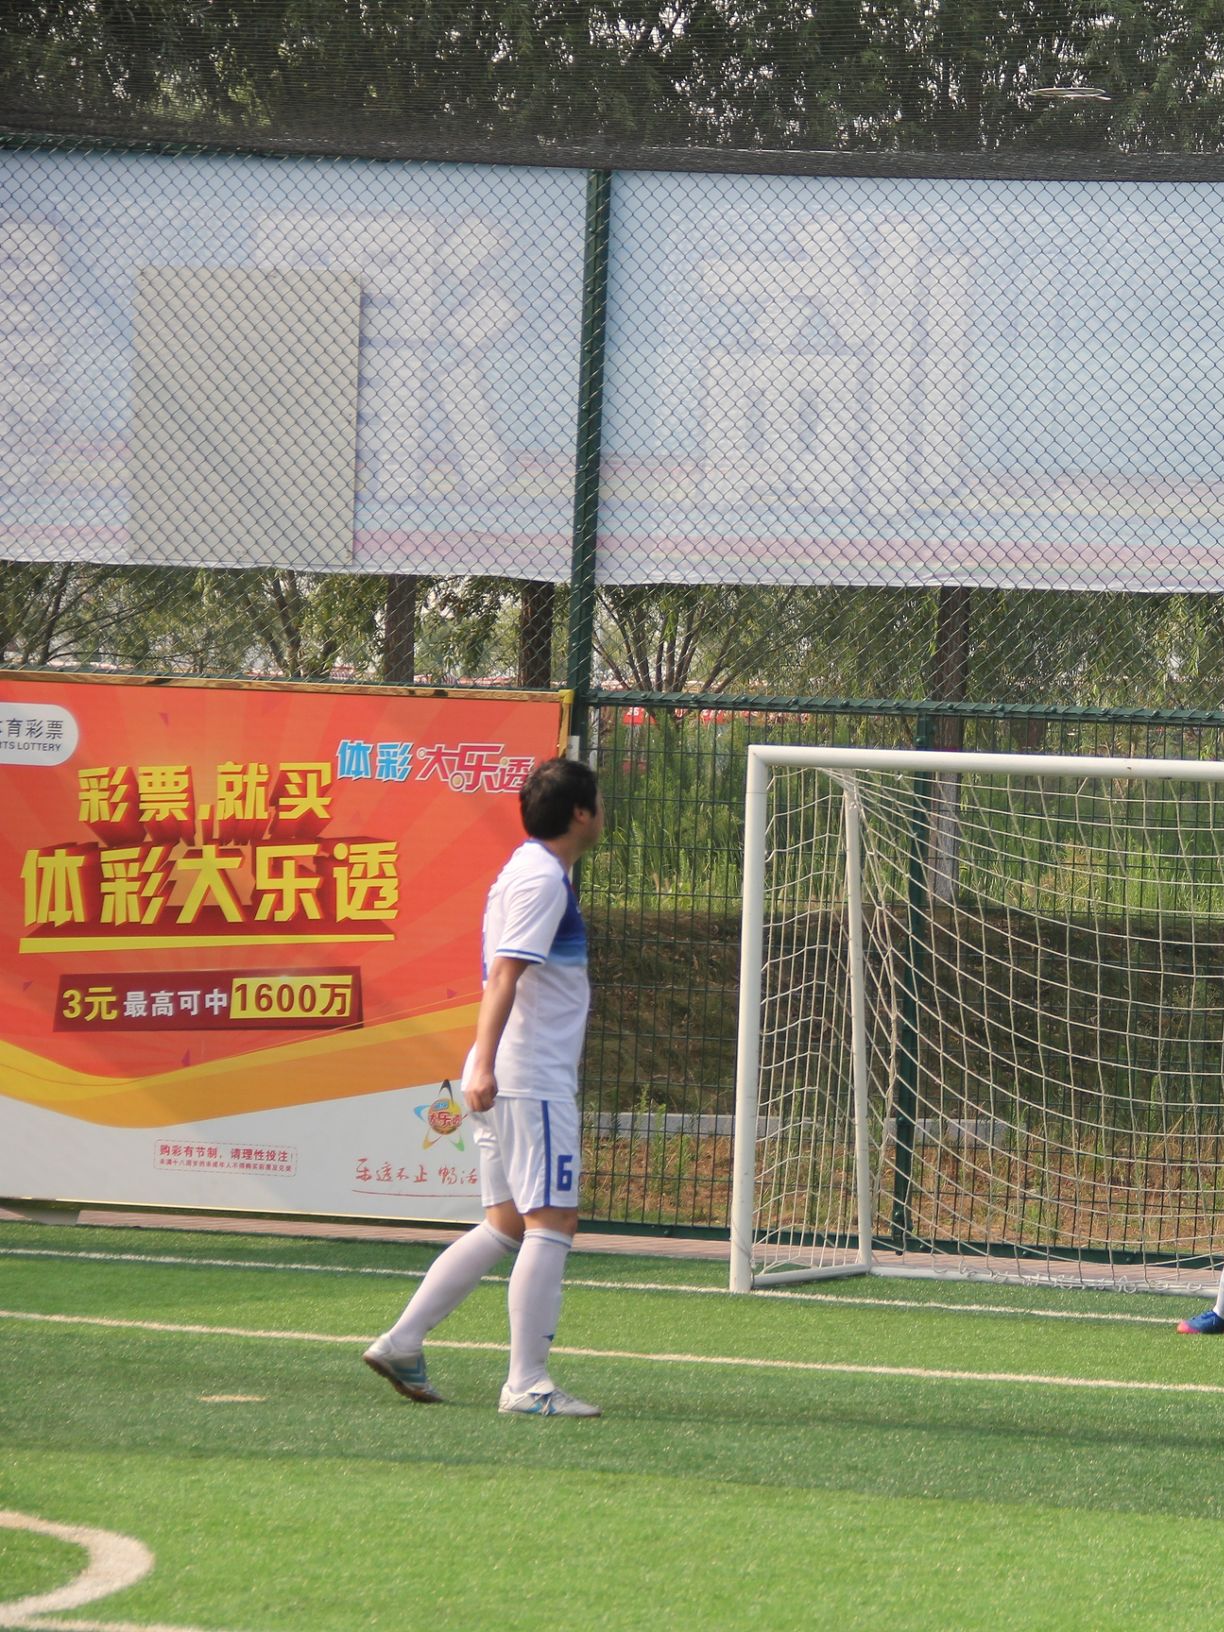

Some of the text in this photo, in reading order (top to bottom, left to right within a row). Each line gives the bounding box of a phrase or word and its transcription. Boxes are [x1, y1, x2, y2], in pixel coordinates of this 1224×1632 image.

[0, 718, 63, 740] 育彩票
[0, 741, 61, 752] TS LOTTERY
[20, 841, 399, 928] 体彩大乐透
[556, 1154, 573, 1191] 6
